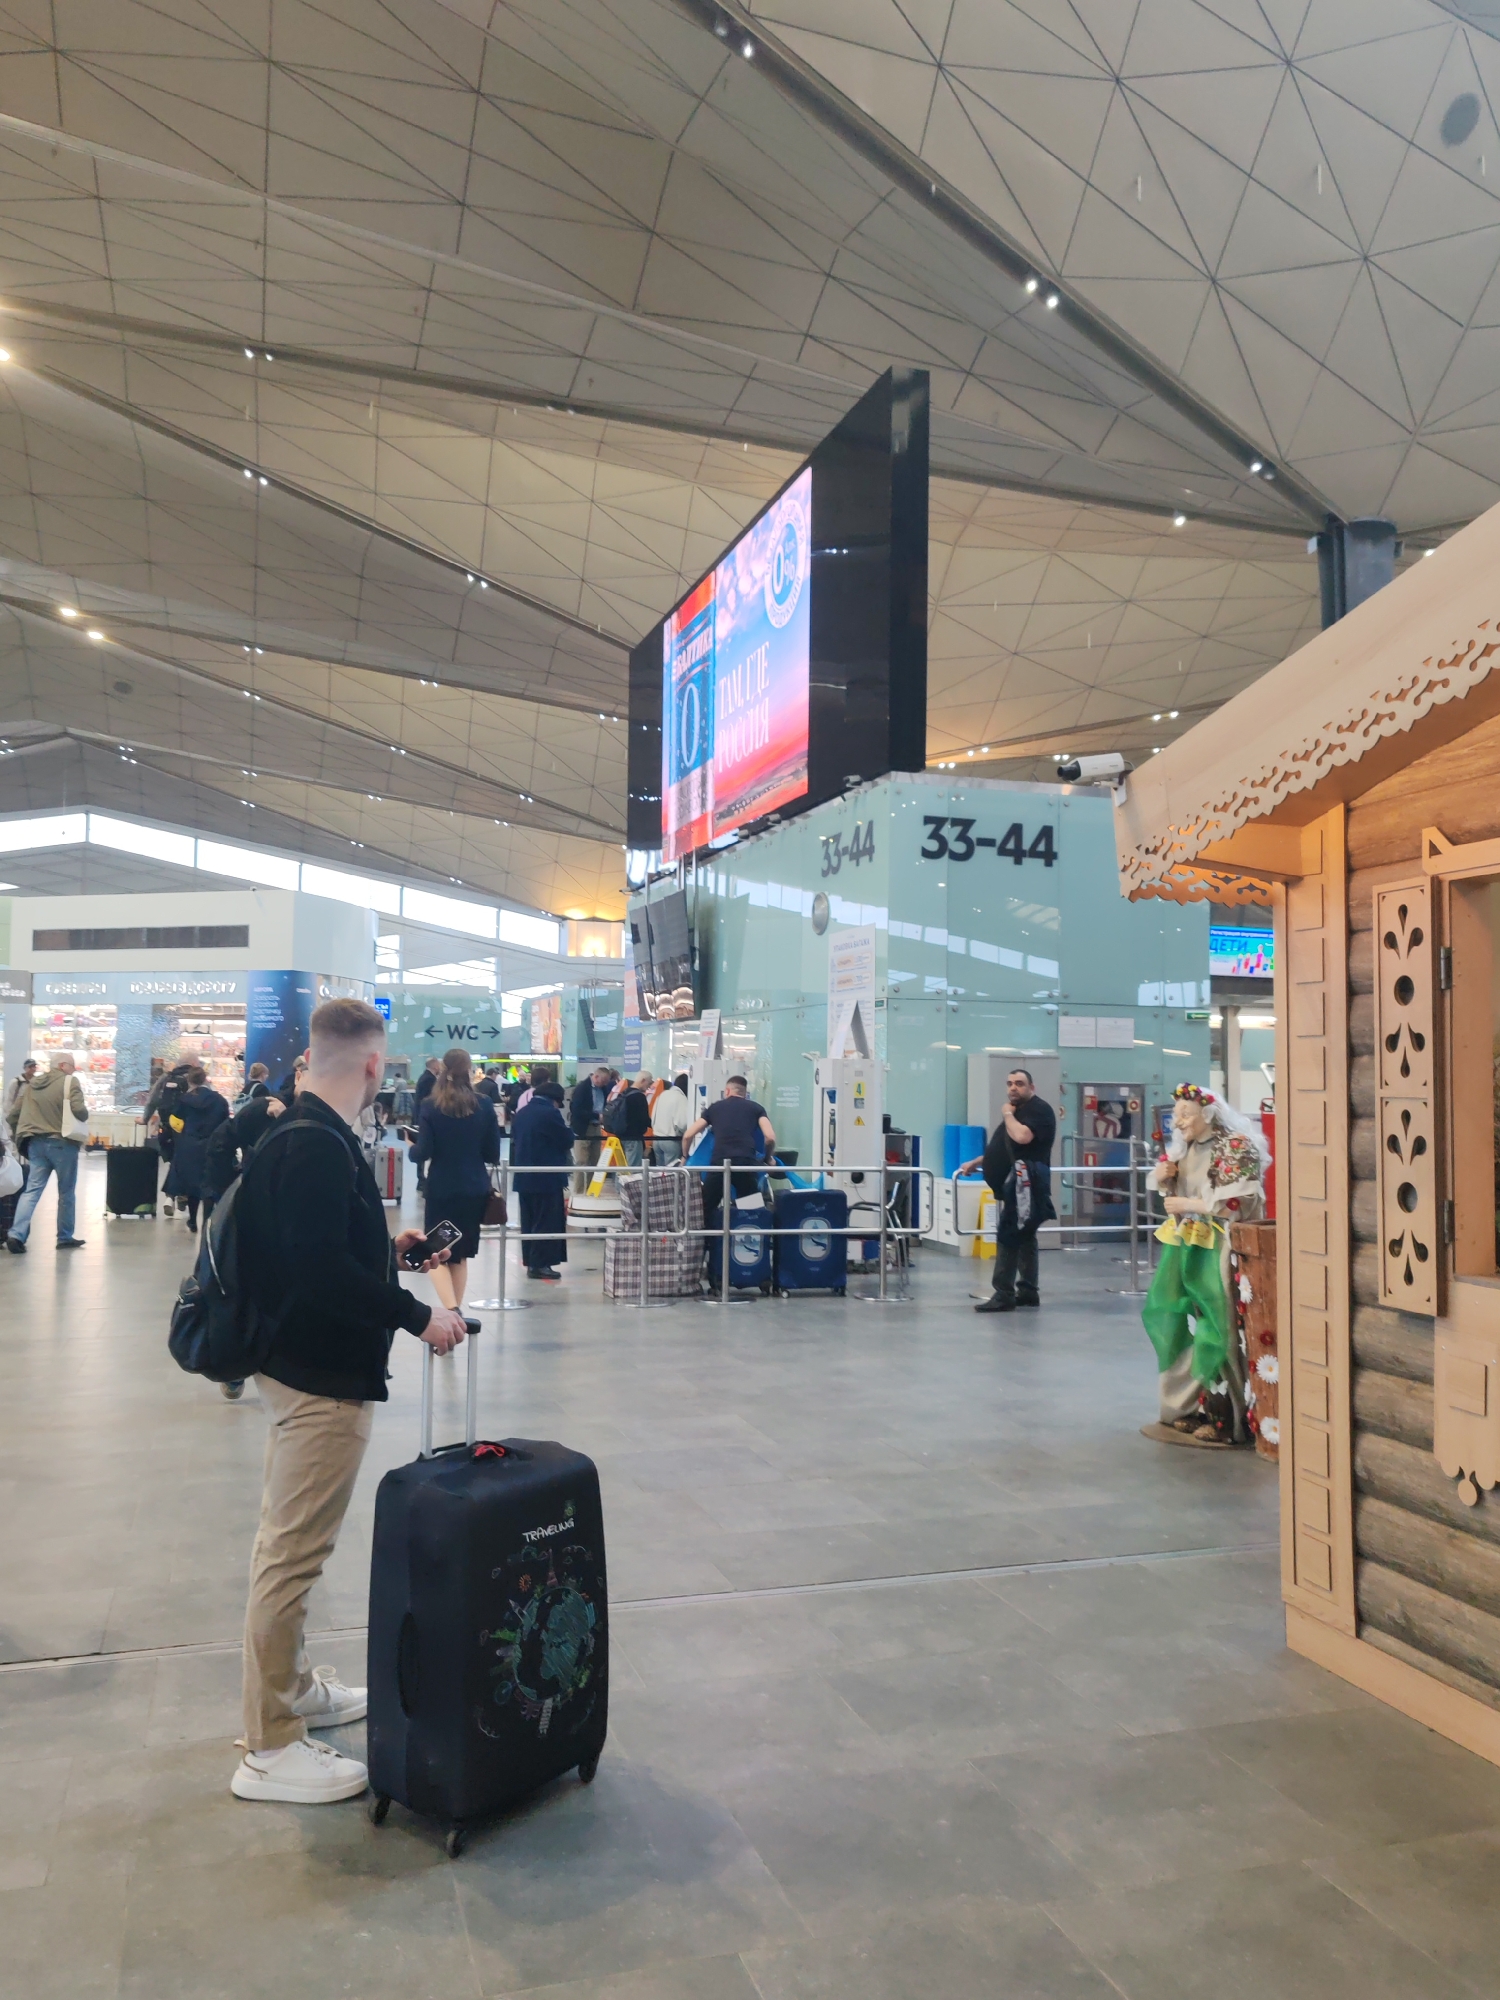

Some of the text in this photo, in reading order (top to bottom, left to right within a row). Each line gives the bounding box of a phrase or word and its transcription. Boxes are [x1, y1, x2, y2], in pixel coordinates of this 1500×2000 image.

[746, 640, 771, 704] ГДЕ
[717, 696, 770, 773] РОССИЯ
[821, 819, 875, 878] 33-44
[921, 815, 1058, 868] 33-44
[1209, 938, 1248, 953] ДЕТИ
[187, 980, 237, 996] ДОРОГУ
[446, 1024, 479, 1040] WC
[521, 1517, 575, 1543] TRAVELING
